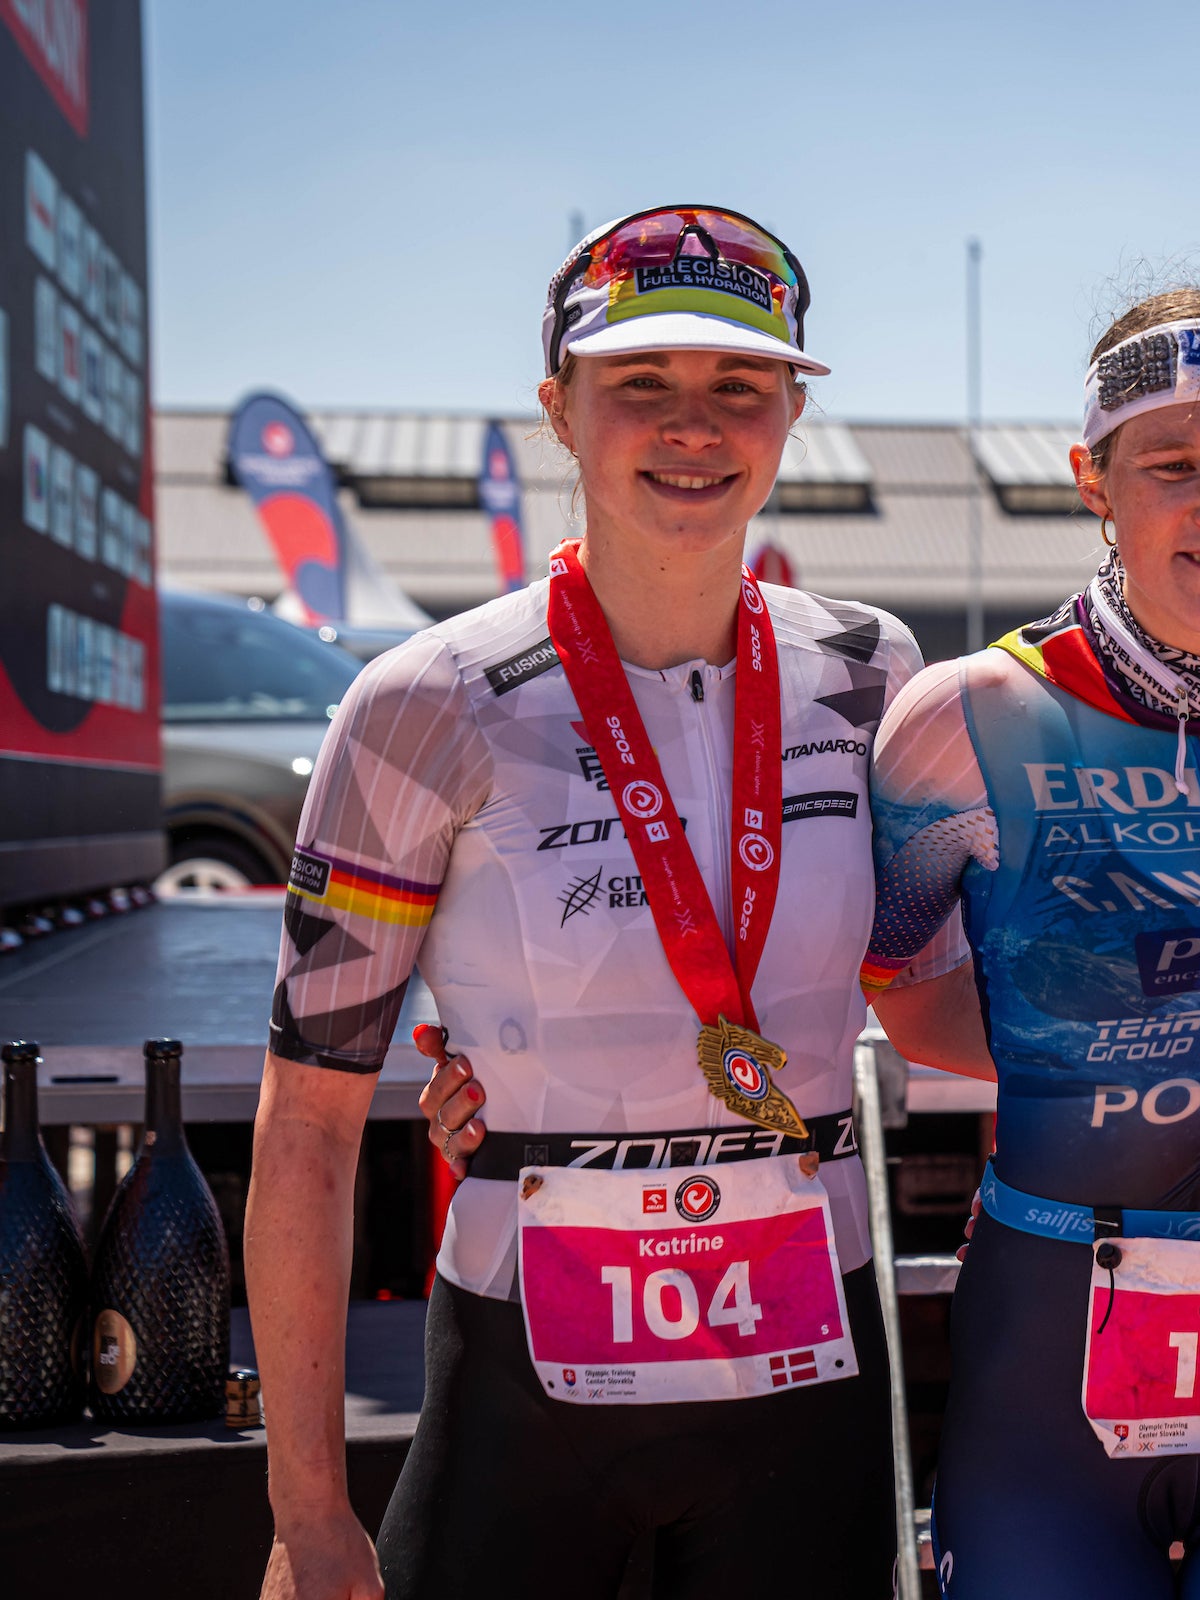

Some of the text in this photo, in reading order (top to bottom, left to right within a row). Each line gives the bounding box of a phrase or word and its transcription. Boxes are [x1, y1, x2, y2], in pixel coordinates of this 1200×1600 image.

[643, 273, 768, 306] FUEL & HYDRATION
[499, 643, 558, 683] FUSION
[750, 624, 763, 673] 2026
[606, 716, 636, 766] 2026
[739, 886, 757, 941] 2026
[1025, 1209, 1095, 1235] sailfis
[638, 1232, 725, 1258] Katrine
[601, 1259, 763, 1344] 104
[820, 1324, 830, 1336] S
[1138, 1431, 1158, 1439] Center
[1164, 1422, 1188, 1430] Training
